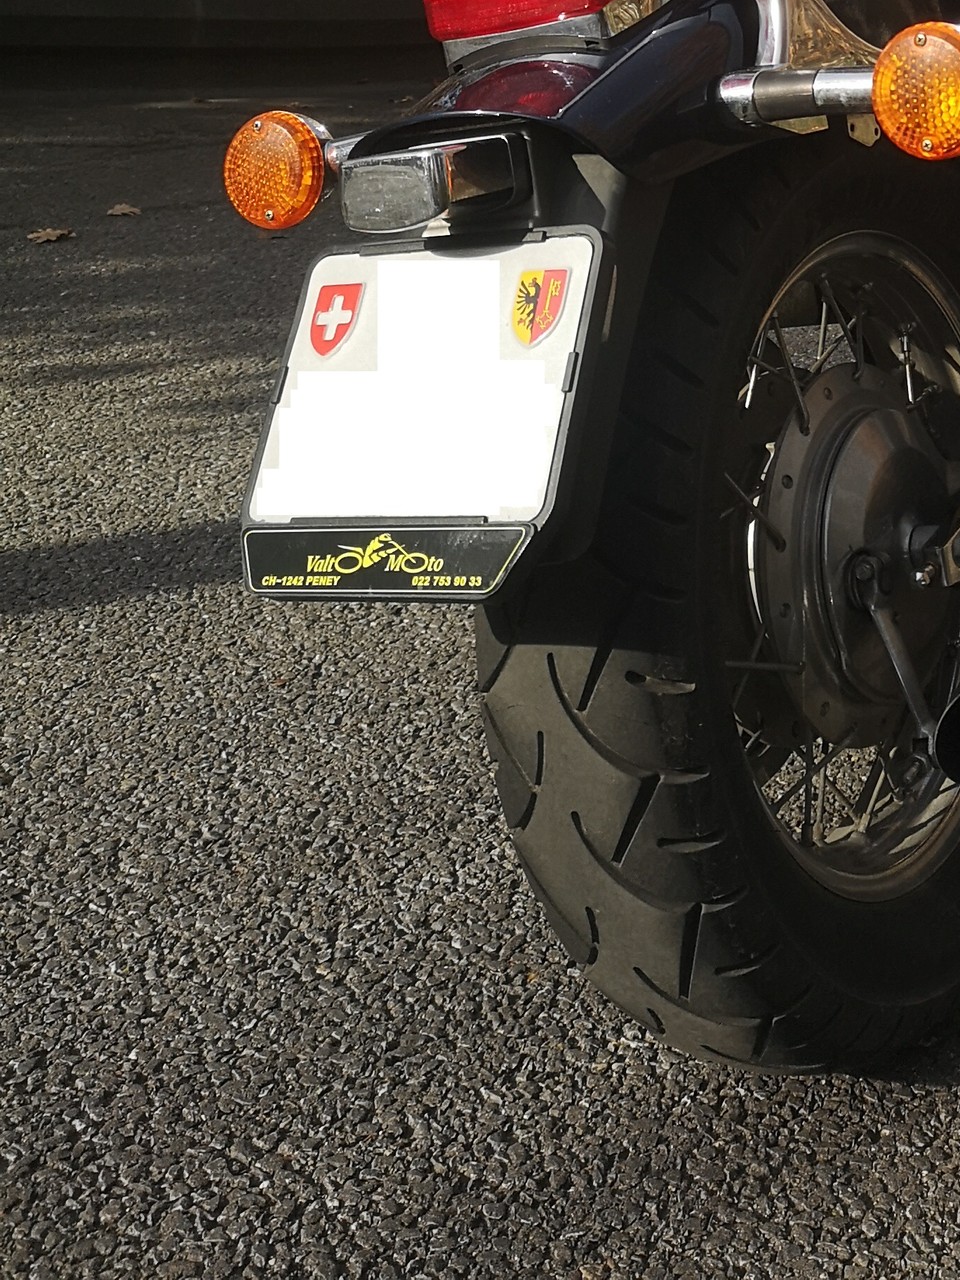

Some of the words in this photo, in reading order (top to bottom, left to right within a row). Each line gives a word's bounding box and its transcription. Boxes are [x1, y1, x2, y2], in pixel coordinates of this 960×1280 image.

[261, 575, 304, 586] CH-1242
[305, 575, 341, 586] PENEY
[411, 575, 431, 586] 022
[432, 575, 452, 586] 753
[453, 575, 467, 586] 90
[468, 575, 482, 587] 33
